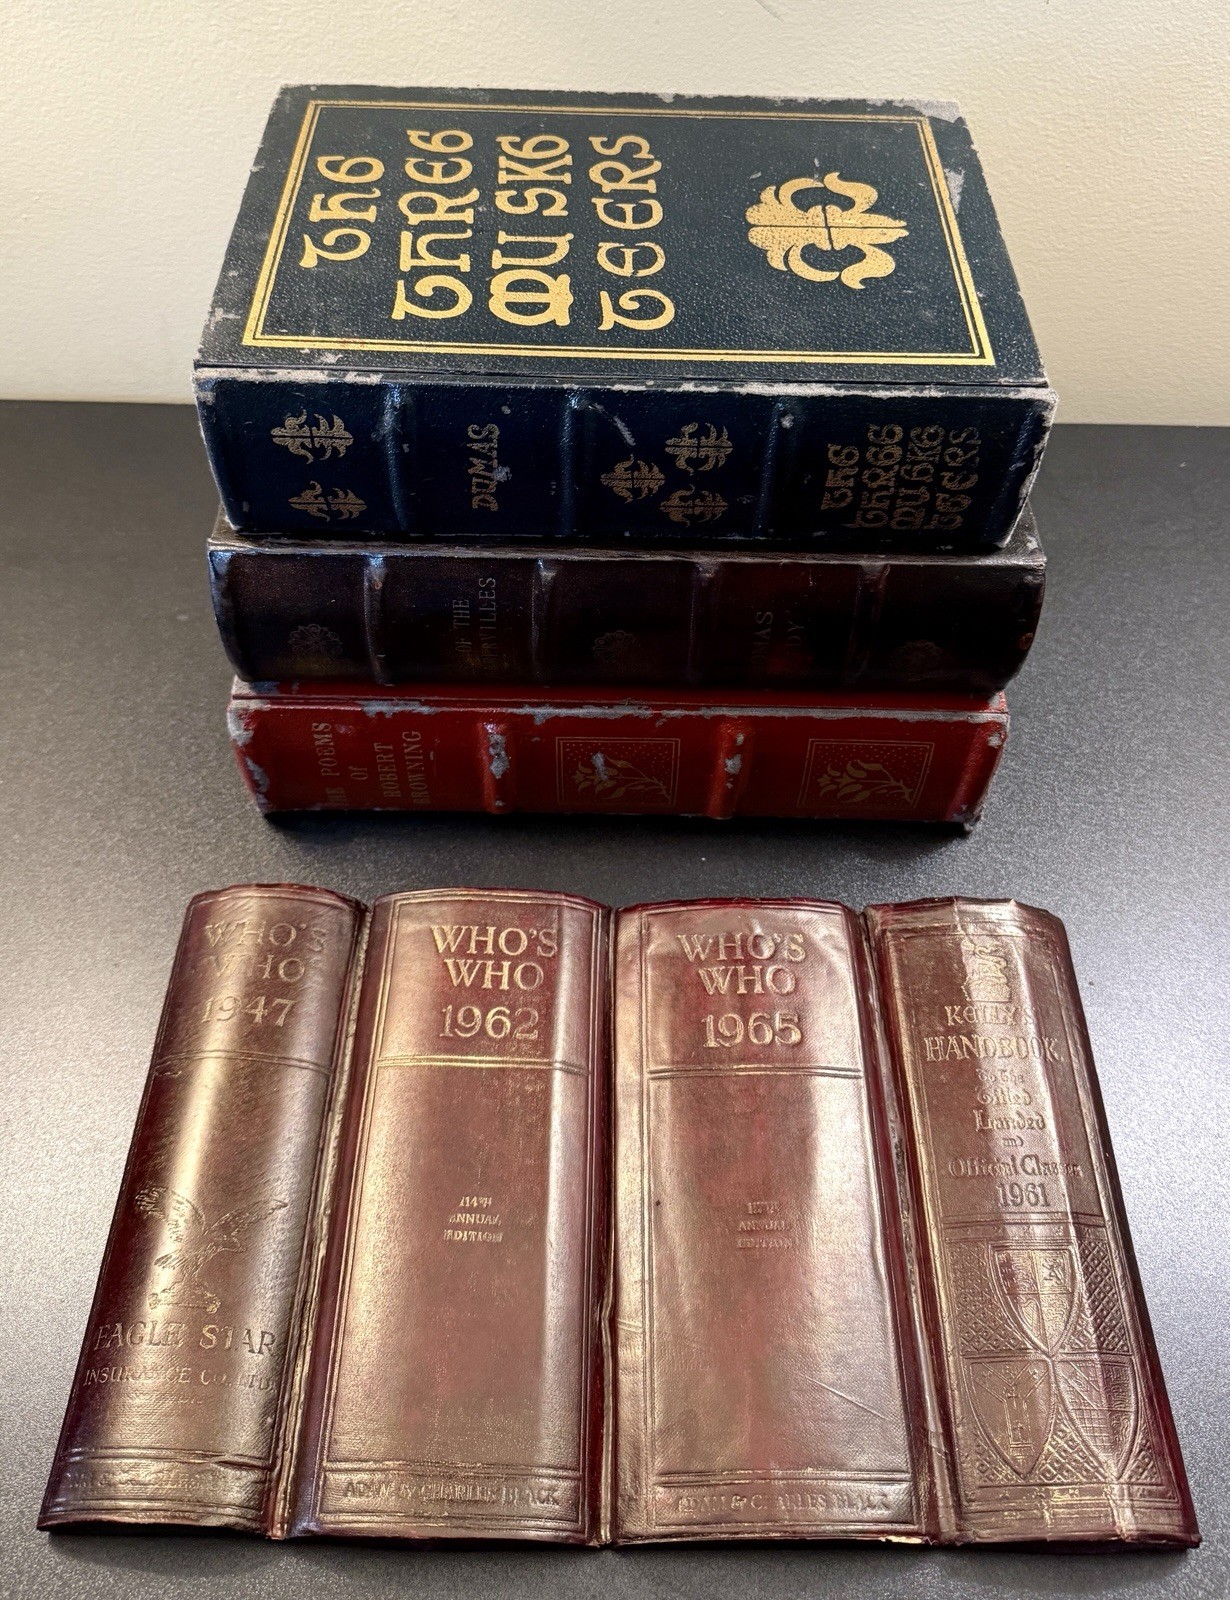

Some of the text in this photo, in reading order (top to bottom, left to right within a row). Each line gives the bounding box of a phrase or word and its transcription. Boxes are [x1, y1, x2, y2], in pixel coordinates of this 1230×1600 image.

[466, 423, 500, 511] DUMAS
[453, 599, 470, 630] THE
[311, 722, 341, 776] POEMS
[374, 742, 402, 798] ROBERT
[402, 731, 432, 805] BROWNING
[203, 920, 327, 952] WHO'S
[430, 925, 558, 958] WHO'S
[676, 932, 806, 963] WHO'S
[205, 952, 306, 983] WHO
[444, 958, 544, 991] WHO
[698, 964, 796, 995] WHO
[202, 995, 296, 1028] 1947
[439, 1004, 539, 1040] 1962
[701, 1011, 802, 1048] 1965
[923, 1035, 1064, 1063] HANDBOOK
[972, 1108, 1047, 1132] Landed
[996, 1182, 1051, 1208] 1961
[448, 1213, 502, 1226] ANNUAL
[443, 1229, 504, 1243] EDITION
[94, 1321, 277, 1356] EAGLE STAR
[731, 1494, 748, 1510] &
